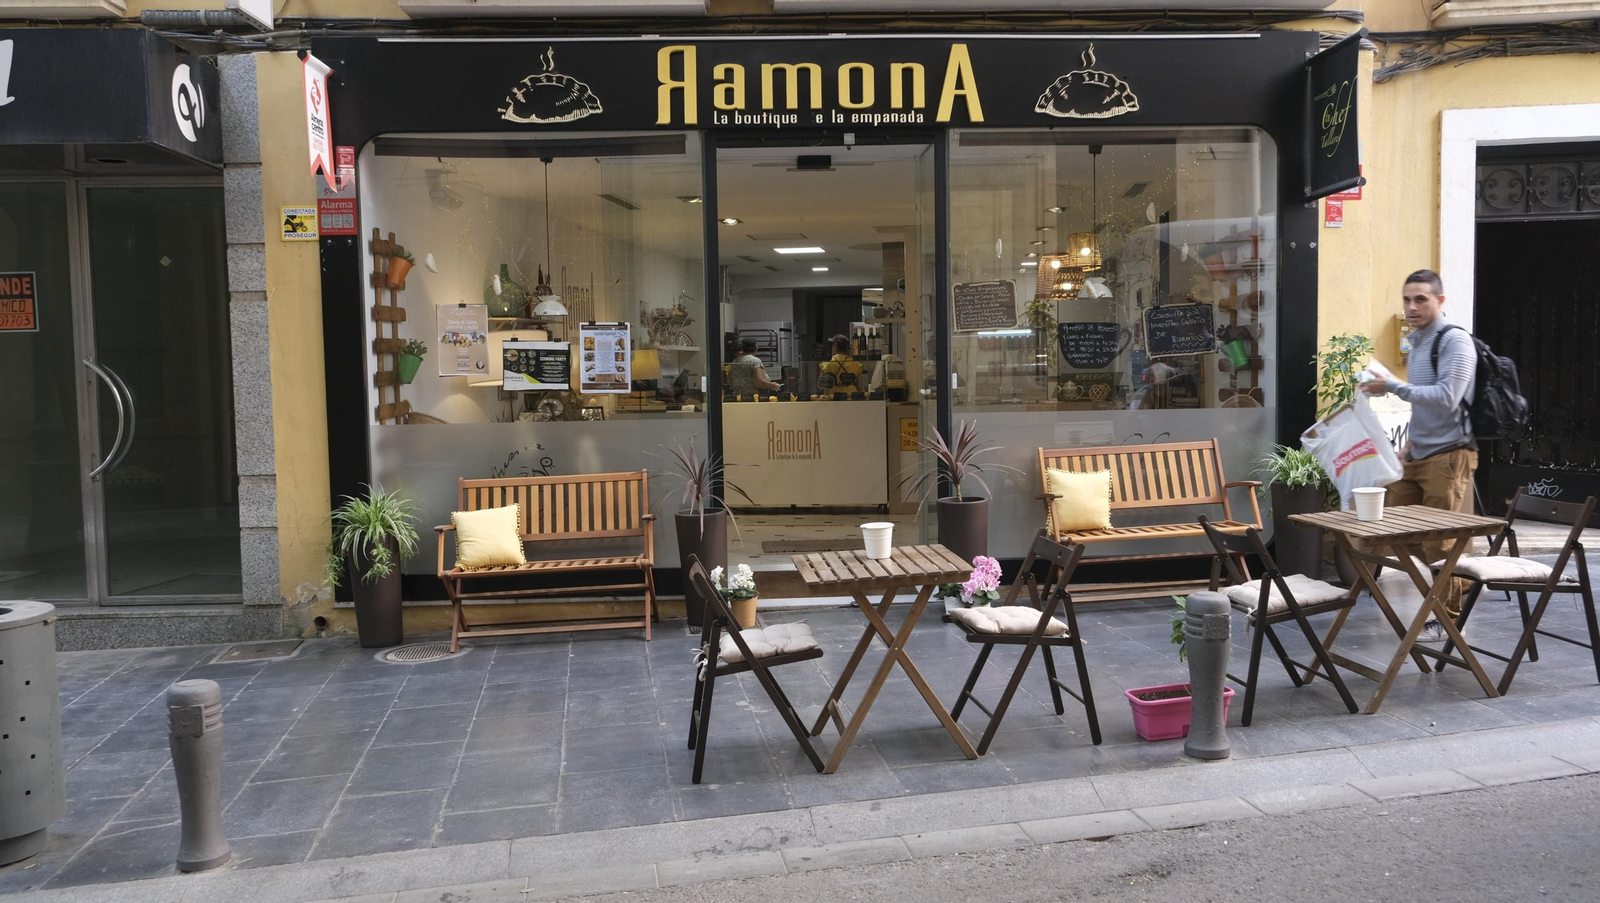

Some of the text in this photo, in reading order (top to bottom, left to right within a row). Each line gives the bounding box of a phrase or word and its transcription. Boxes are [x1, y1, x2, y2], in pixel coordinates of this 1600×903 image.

[714, 110, 728, 125] La
[735, 110, 798, 129] boutique
[832, 109, 844, 124] la
[851, 110, 924, 127] empanada
[321, 201, 353, 209] Alarma
